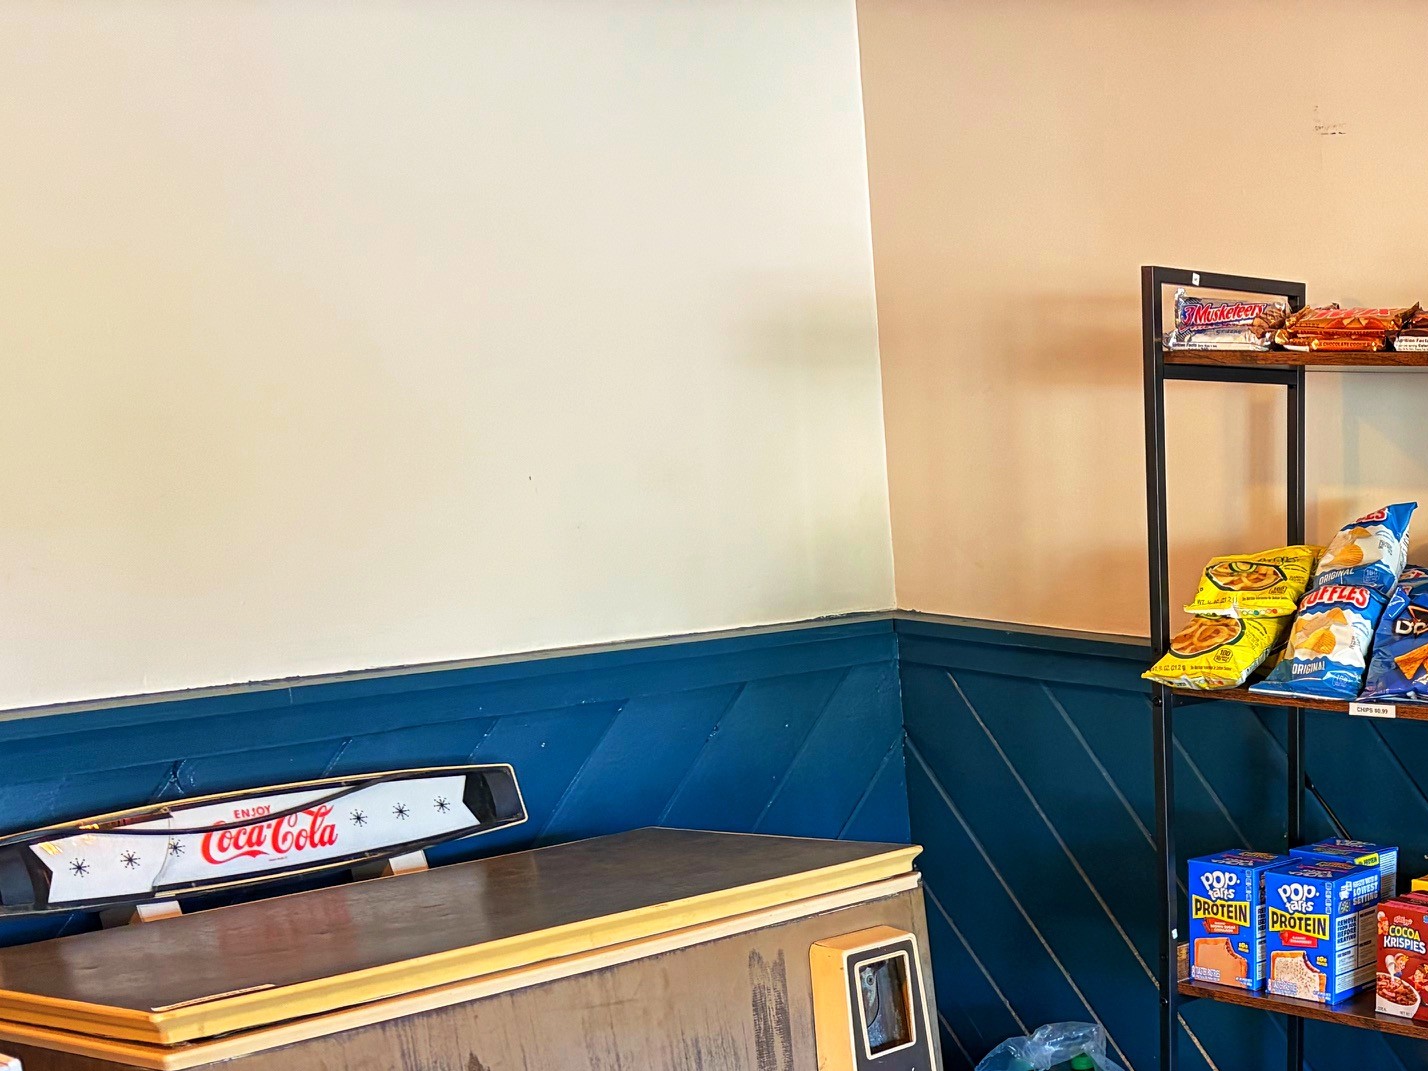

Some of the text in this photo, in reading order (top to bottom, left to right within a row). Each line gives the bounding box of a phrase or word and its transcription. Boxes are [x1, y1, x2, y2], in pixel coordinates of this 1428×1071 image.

[1194, 303, 1267, 324] Musketeers
[1319, 568, 1354, 584] ORIGINAL
[1292, 661, 1325, 674] ORIGINAL
[233, 805, 271, 820] ENJOY
[200, 804, 338, 865] Coca-Cola
[1353, 882, 1378, 897] LOWEST
[1353, 891, 1378, 905] SETTING
[1195, 898, 1247, 923] PROTEIN
[1271, 911, 1326, 936] PROTEIN
[1389, 925, 1420, 941] COCOA
[1384, 936, 1426, 954] KRISPIES
